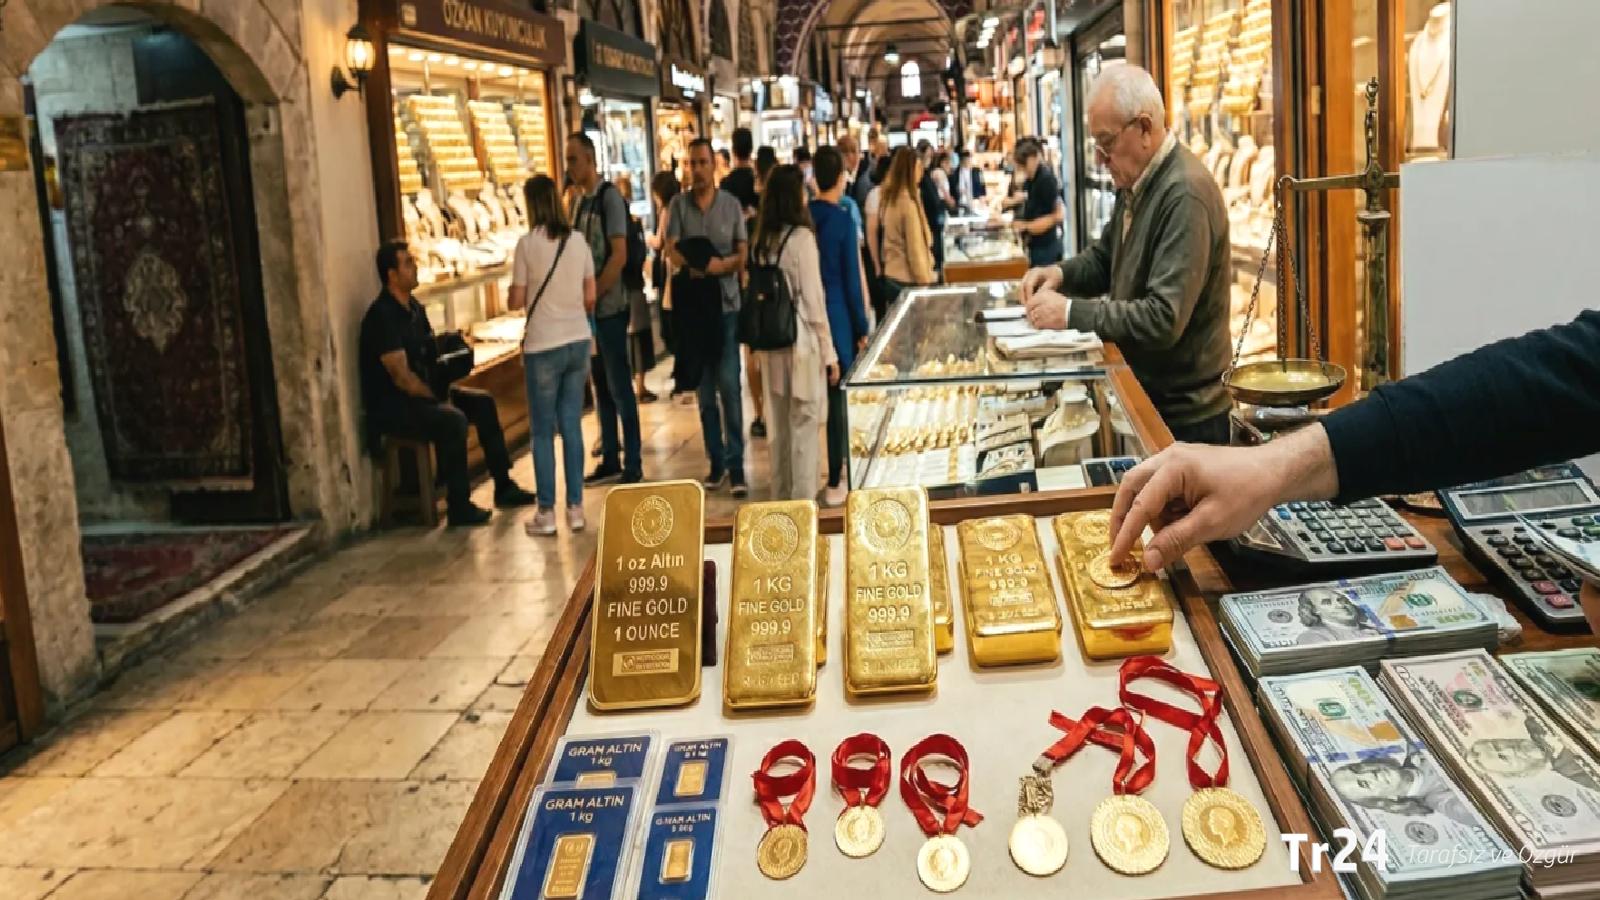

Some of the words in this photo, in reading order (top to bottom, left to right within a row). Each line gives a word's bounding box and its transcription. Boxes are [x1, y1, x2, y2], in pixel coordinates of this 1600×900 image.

[616, 555, 623, 572] 1
[628, 558, 646, 571] oz
[868, 562, 878, 580] 1
[884, 561, 908, 579] KG
[629, 575, 668, 594] 999.9
[753, 578, 761, 594] 1
[767, 576, 792, 594] KG
[856, 587, 883, 602] FINE
[887, 583, 922, 599] GOLD
[607, 600, 642, 618] FINE
[645, 597, 687, 616] GOLD
[738, 601, 767, 616] FINE
[770, 599, 804, 614] GOLD
[868, 604, 911, 623] 999.9
[614, 626, 622, 642] 1
[626, 622, 680, 641] OUNCE
[751, 619, 791, 636] 999.9
[568, 745, 605, 757] GRAM
[606, 743, 642, 755] ALTIN
[545, 798, 584, 810] GRAM
[585, 795, 625, 808] ALTIN
[569, 812, 576, 822] 1
[578, 810, 594, 824] kg
